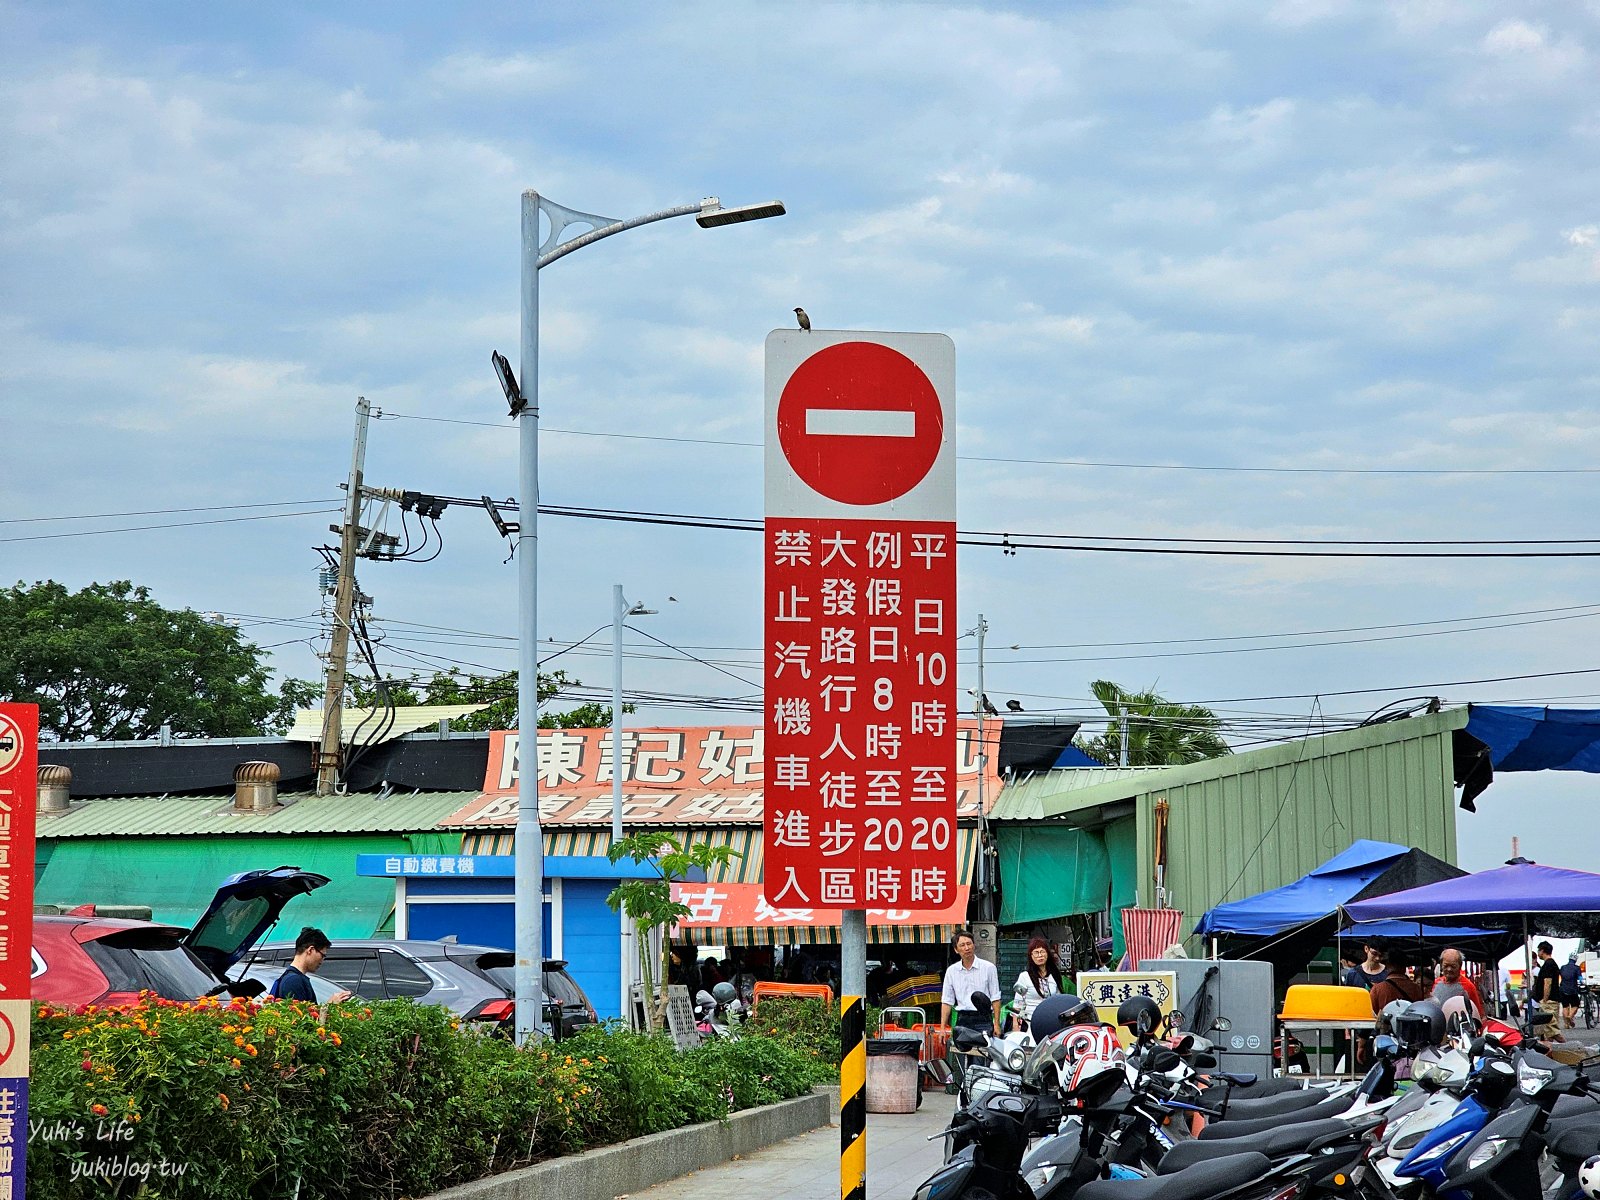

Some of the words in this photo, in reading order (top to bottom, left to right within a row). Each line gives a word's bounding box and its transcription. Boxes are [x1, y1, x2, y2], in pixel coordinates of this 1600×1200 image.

[385, 857, 475, 874] 自動繳費機
[773, 529, 812, 903] 禁止汽機車進入
[819, 530, 857, 904] 大發路行人徒步區
[863, 531, 903, 903] 例假日8時至20時
[910, 533, 950, 904] 平日10時至20時
